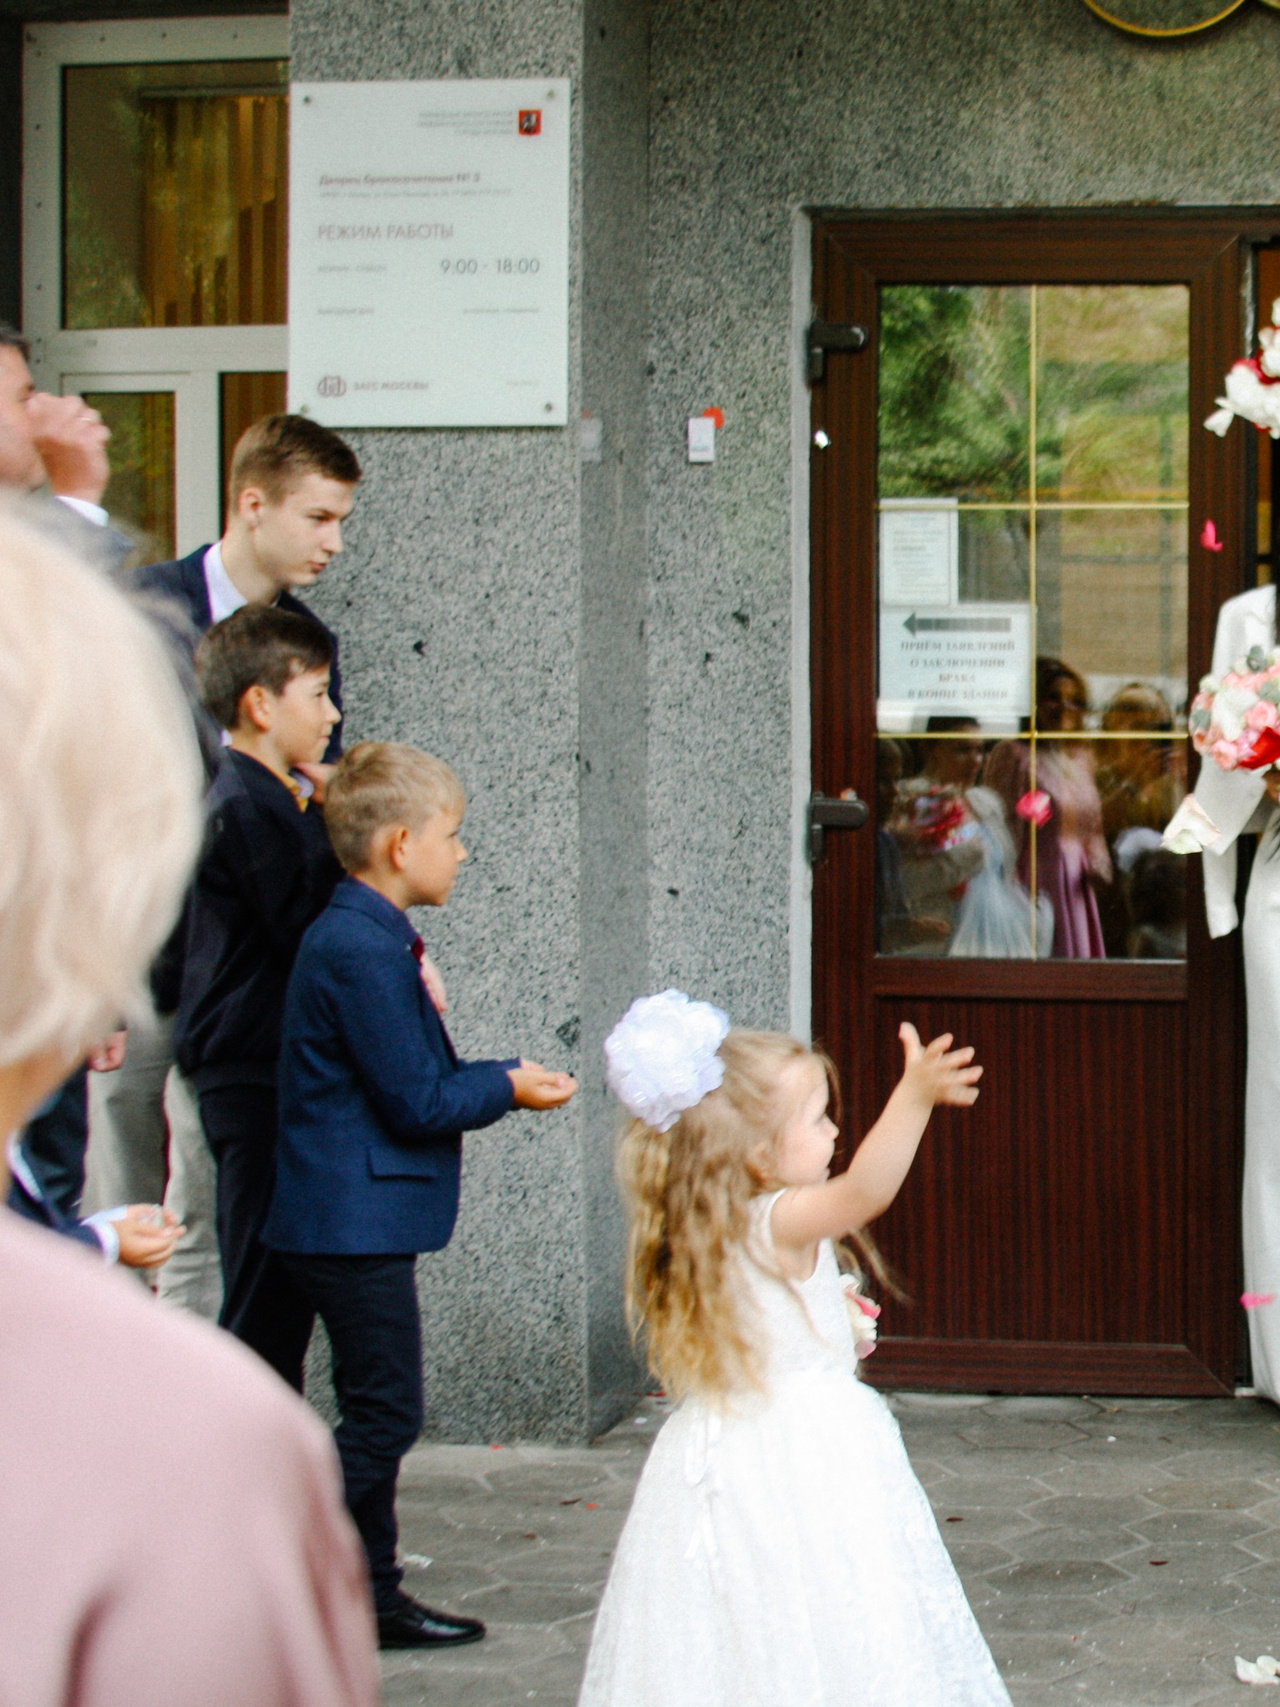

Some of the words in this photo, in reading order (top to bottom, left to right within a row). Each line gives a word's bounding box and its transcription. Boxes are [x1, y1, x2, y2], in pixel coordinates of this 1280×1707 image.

[318, 225, 382, 240] РЕЖИМ
[387, 223, 454, 240] РАБОТЫ
[440, 257, 478, 274] 9:00
[496, 257, 540, 274] 18:00
[938, 673, 976, 683] БРАКА
